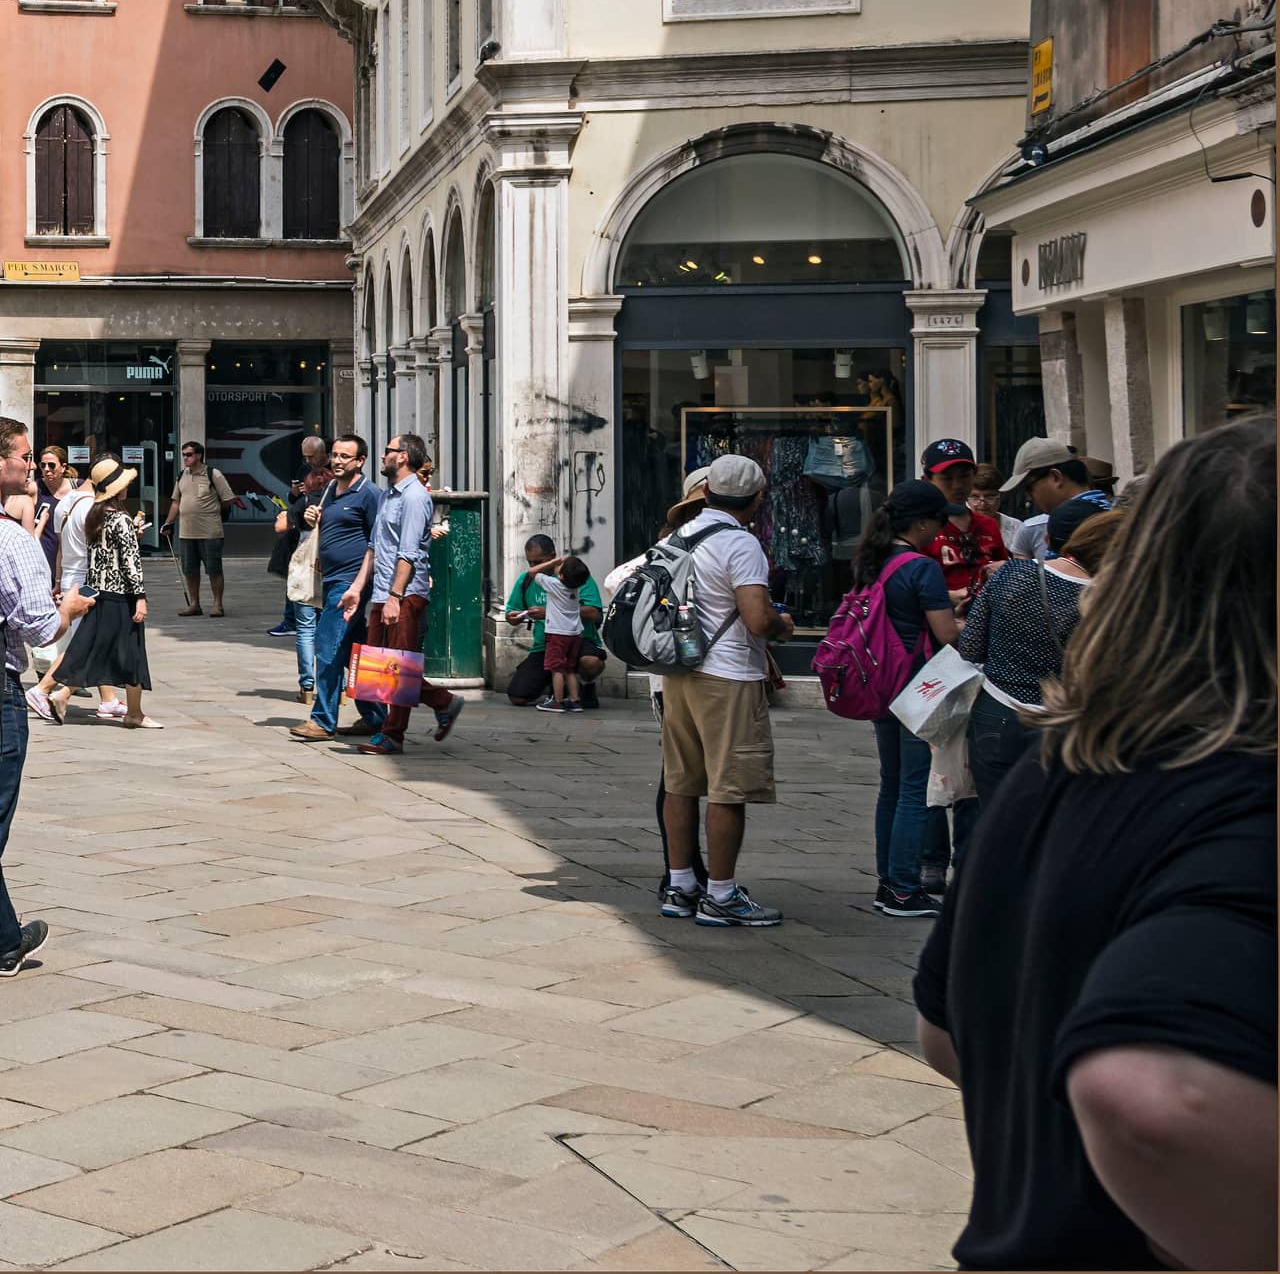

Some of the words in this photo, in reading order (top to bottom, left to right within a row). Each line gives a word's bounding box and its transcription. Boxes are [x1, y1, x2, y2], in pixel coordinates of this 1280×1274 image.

[7, 263, 28, 271] PER
[126, 366, 163, 379] PUMA
[207, 391, 268, 402] OTORSPORT
